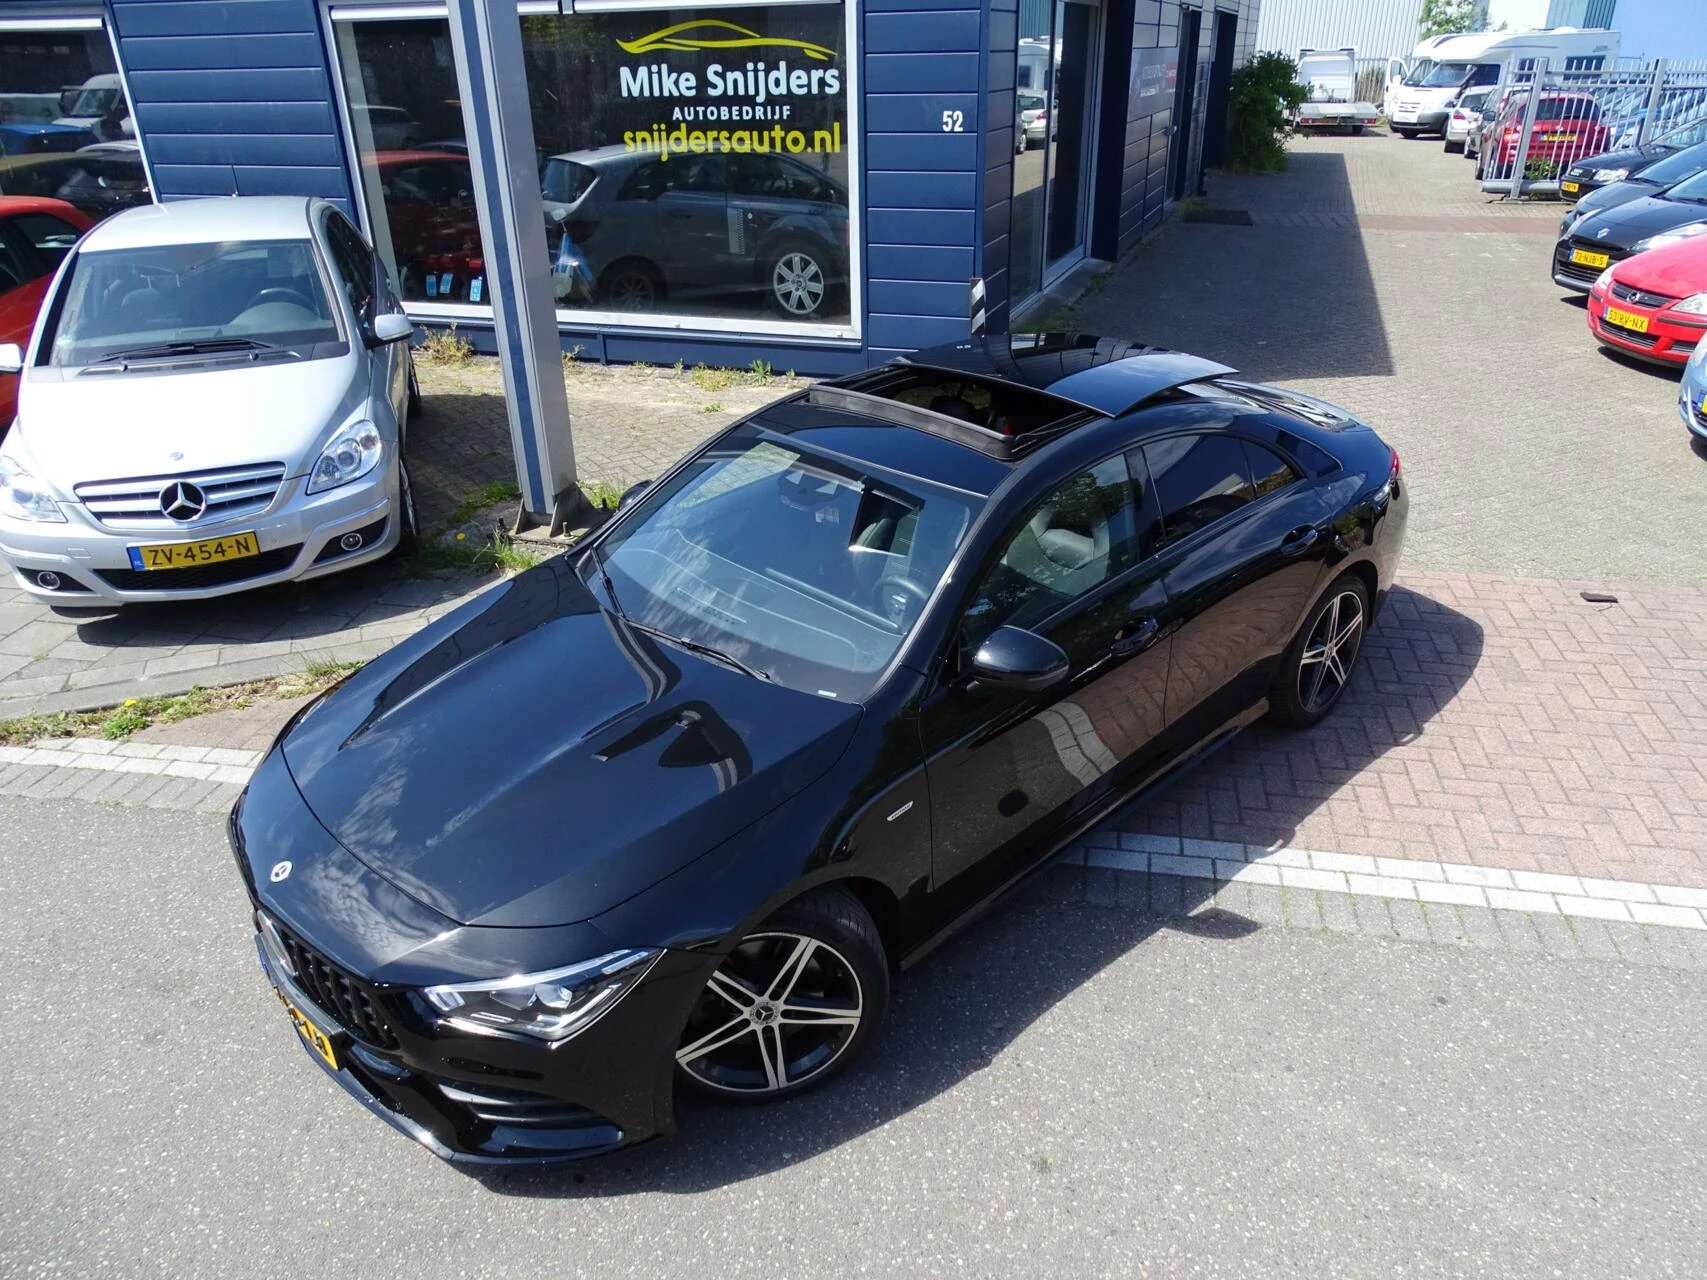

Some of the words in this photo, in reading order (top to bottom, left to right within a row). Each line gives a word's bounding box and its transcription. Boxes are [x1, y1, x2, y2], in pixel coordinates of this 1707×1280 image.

[620, 63, 697, 97] Mike
[706, 60, 840, 103] Snijders
[672, 105, 791, 121] AUTOBEDRIJF
[942, 110, 964, 132] 52
[623, 122, 841, 162] snijdersauto.nl
[148, 537, 251, 566] ZV-454-N
